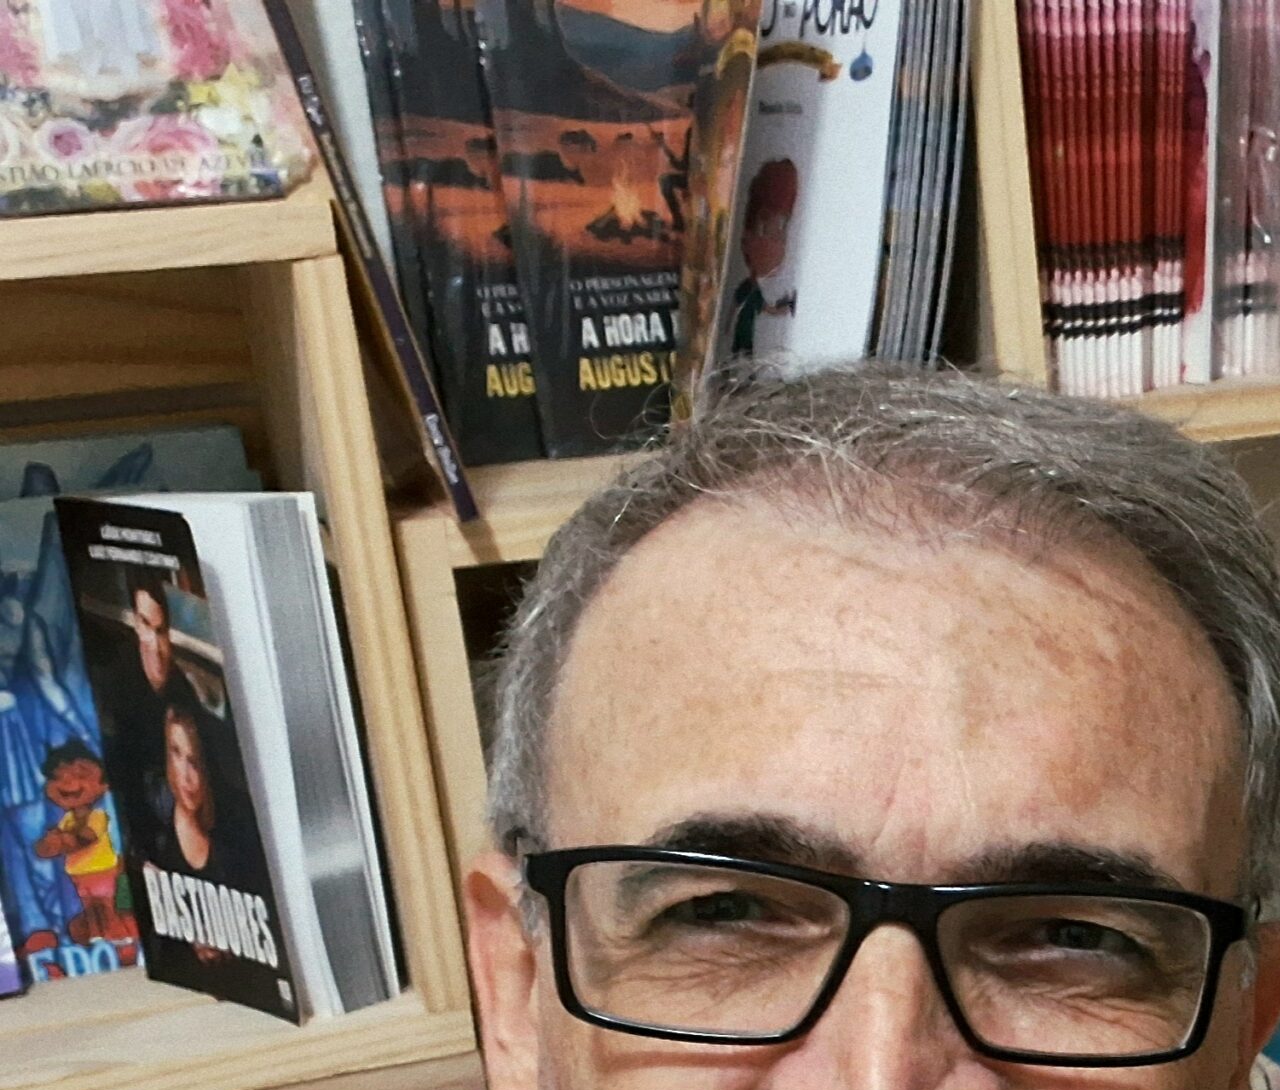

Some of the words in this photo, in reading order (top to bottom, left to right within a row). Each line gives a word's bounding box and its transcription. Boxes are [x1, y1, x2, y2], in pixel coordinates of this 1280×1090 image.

[488, 322, 507, 355] A
[581, 315, 600, 349] A
[603, 311, 668, 347] HORA
[143, 863, 278, 969] BASTIDORES
